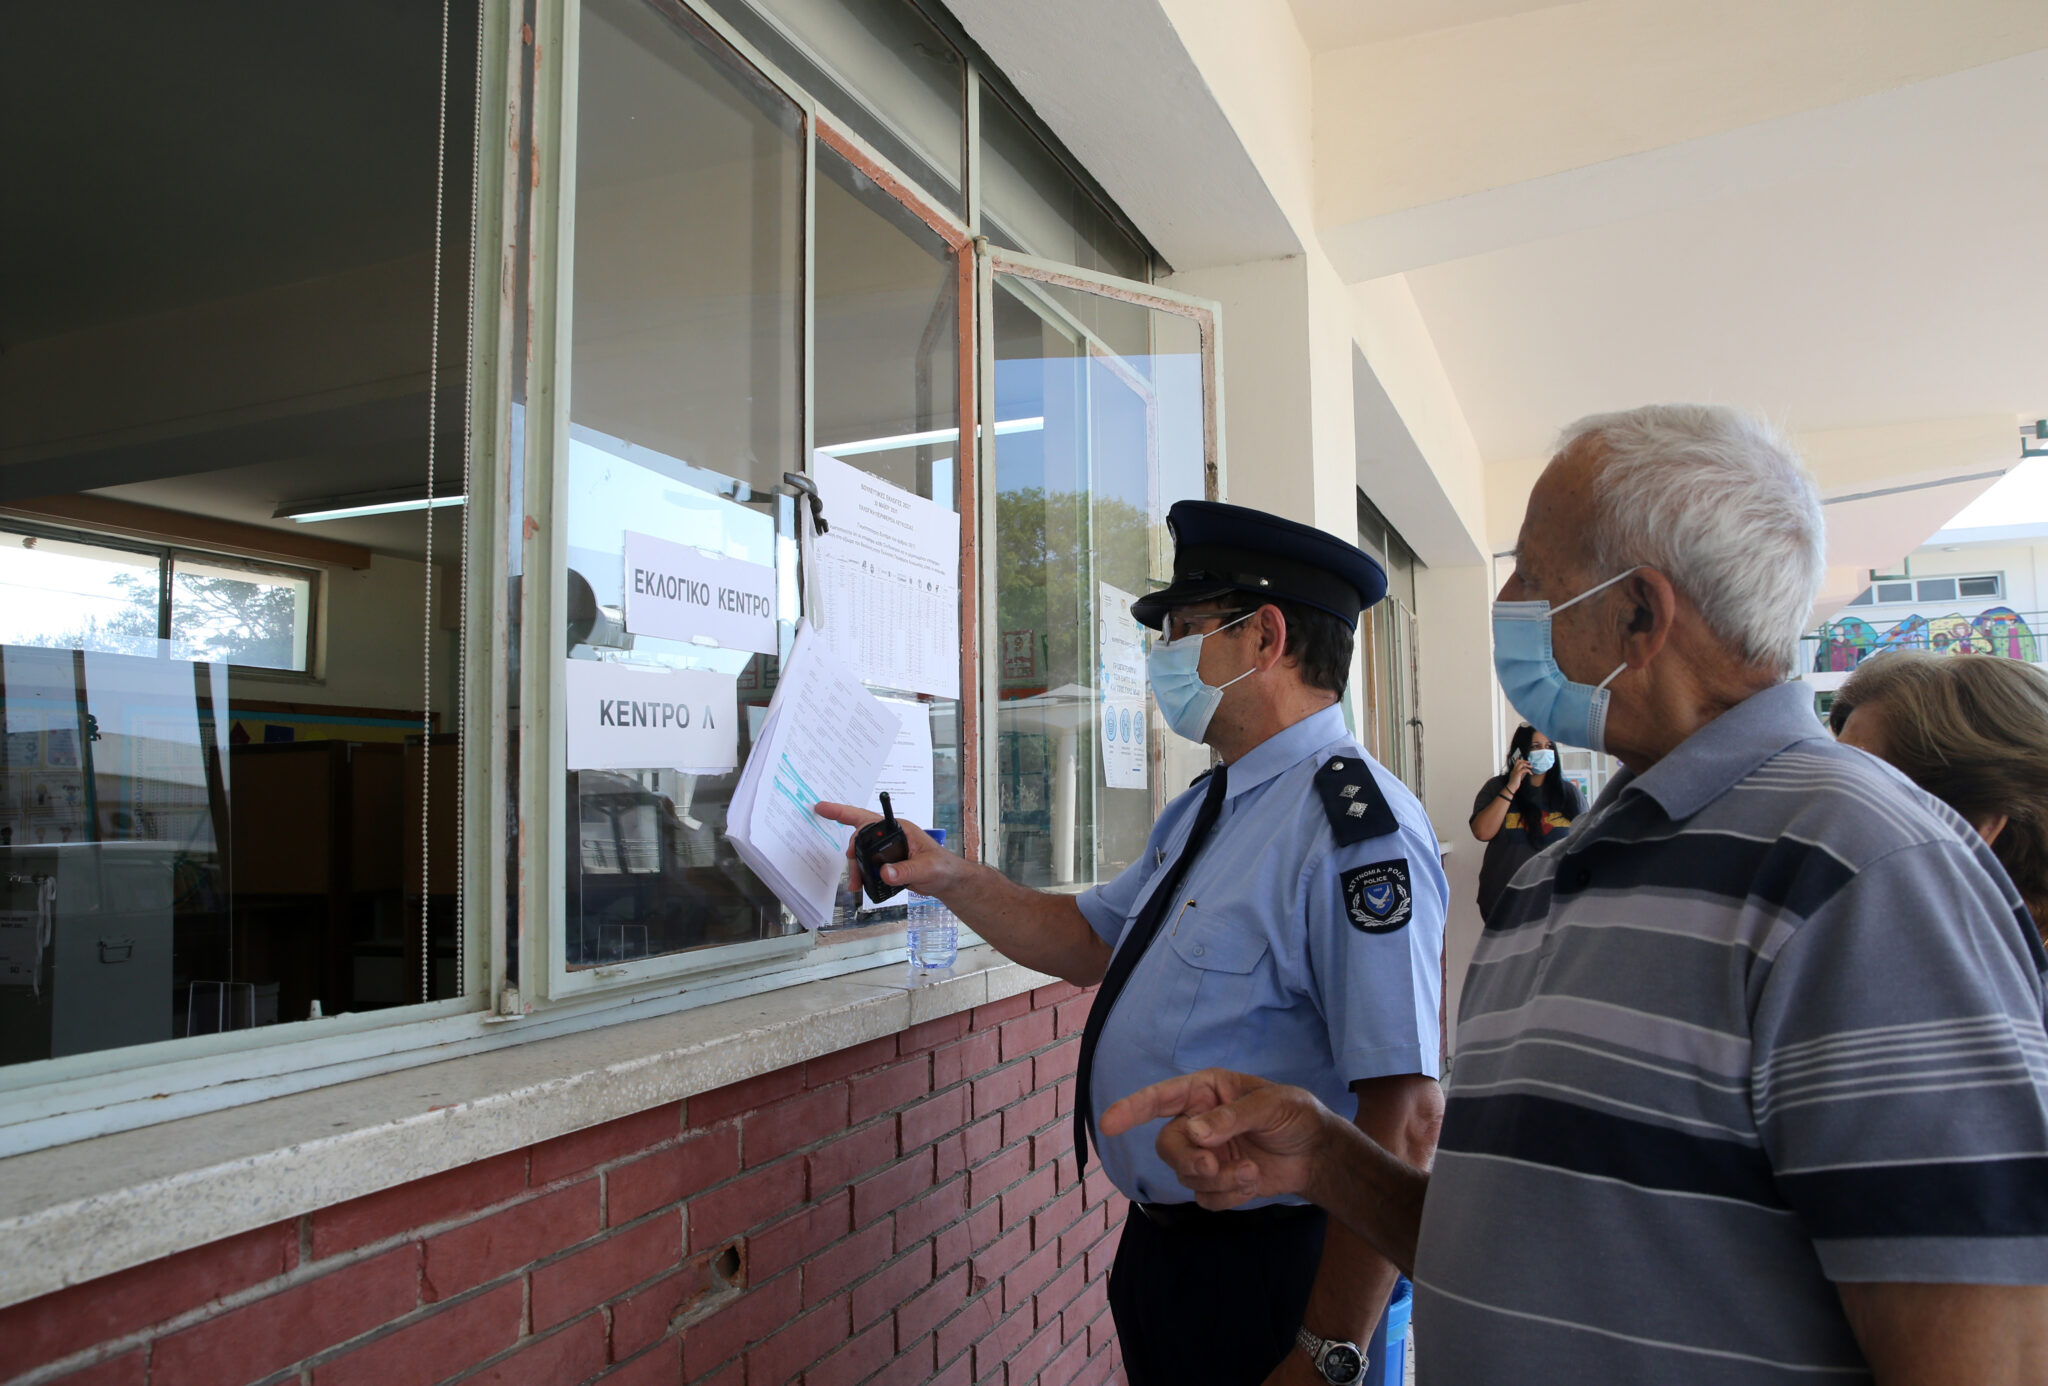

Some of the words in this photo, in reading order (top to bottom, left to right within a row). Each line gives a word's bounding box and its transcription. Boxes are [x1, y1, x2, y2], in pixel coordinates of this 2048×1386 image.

[634, 568, 710, 606] ΕΚΛΟΓΙΚΟ
[718, 586, 770, 619] ΚΕΝΤΡΟ
[600, 699, 690, 729] ΚΕΝΤΡΟ
[702, 704, 715, 729] Λ
[1364, 876, 1387, 885] POLICE
[1387, 867, 1406, 881] POLIS
